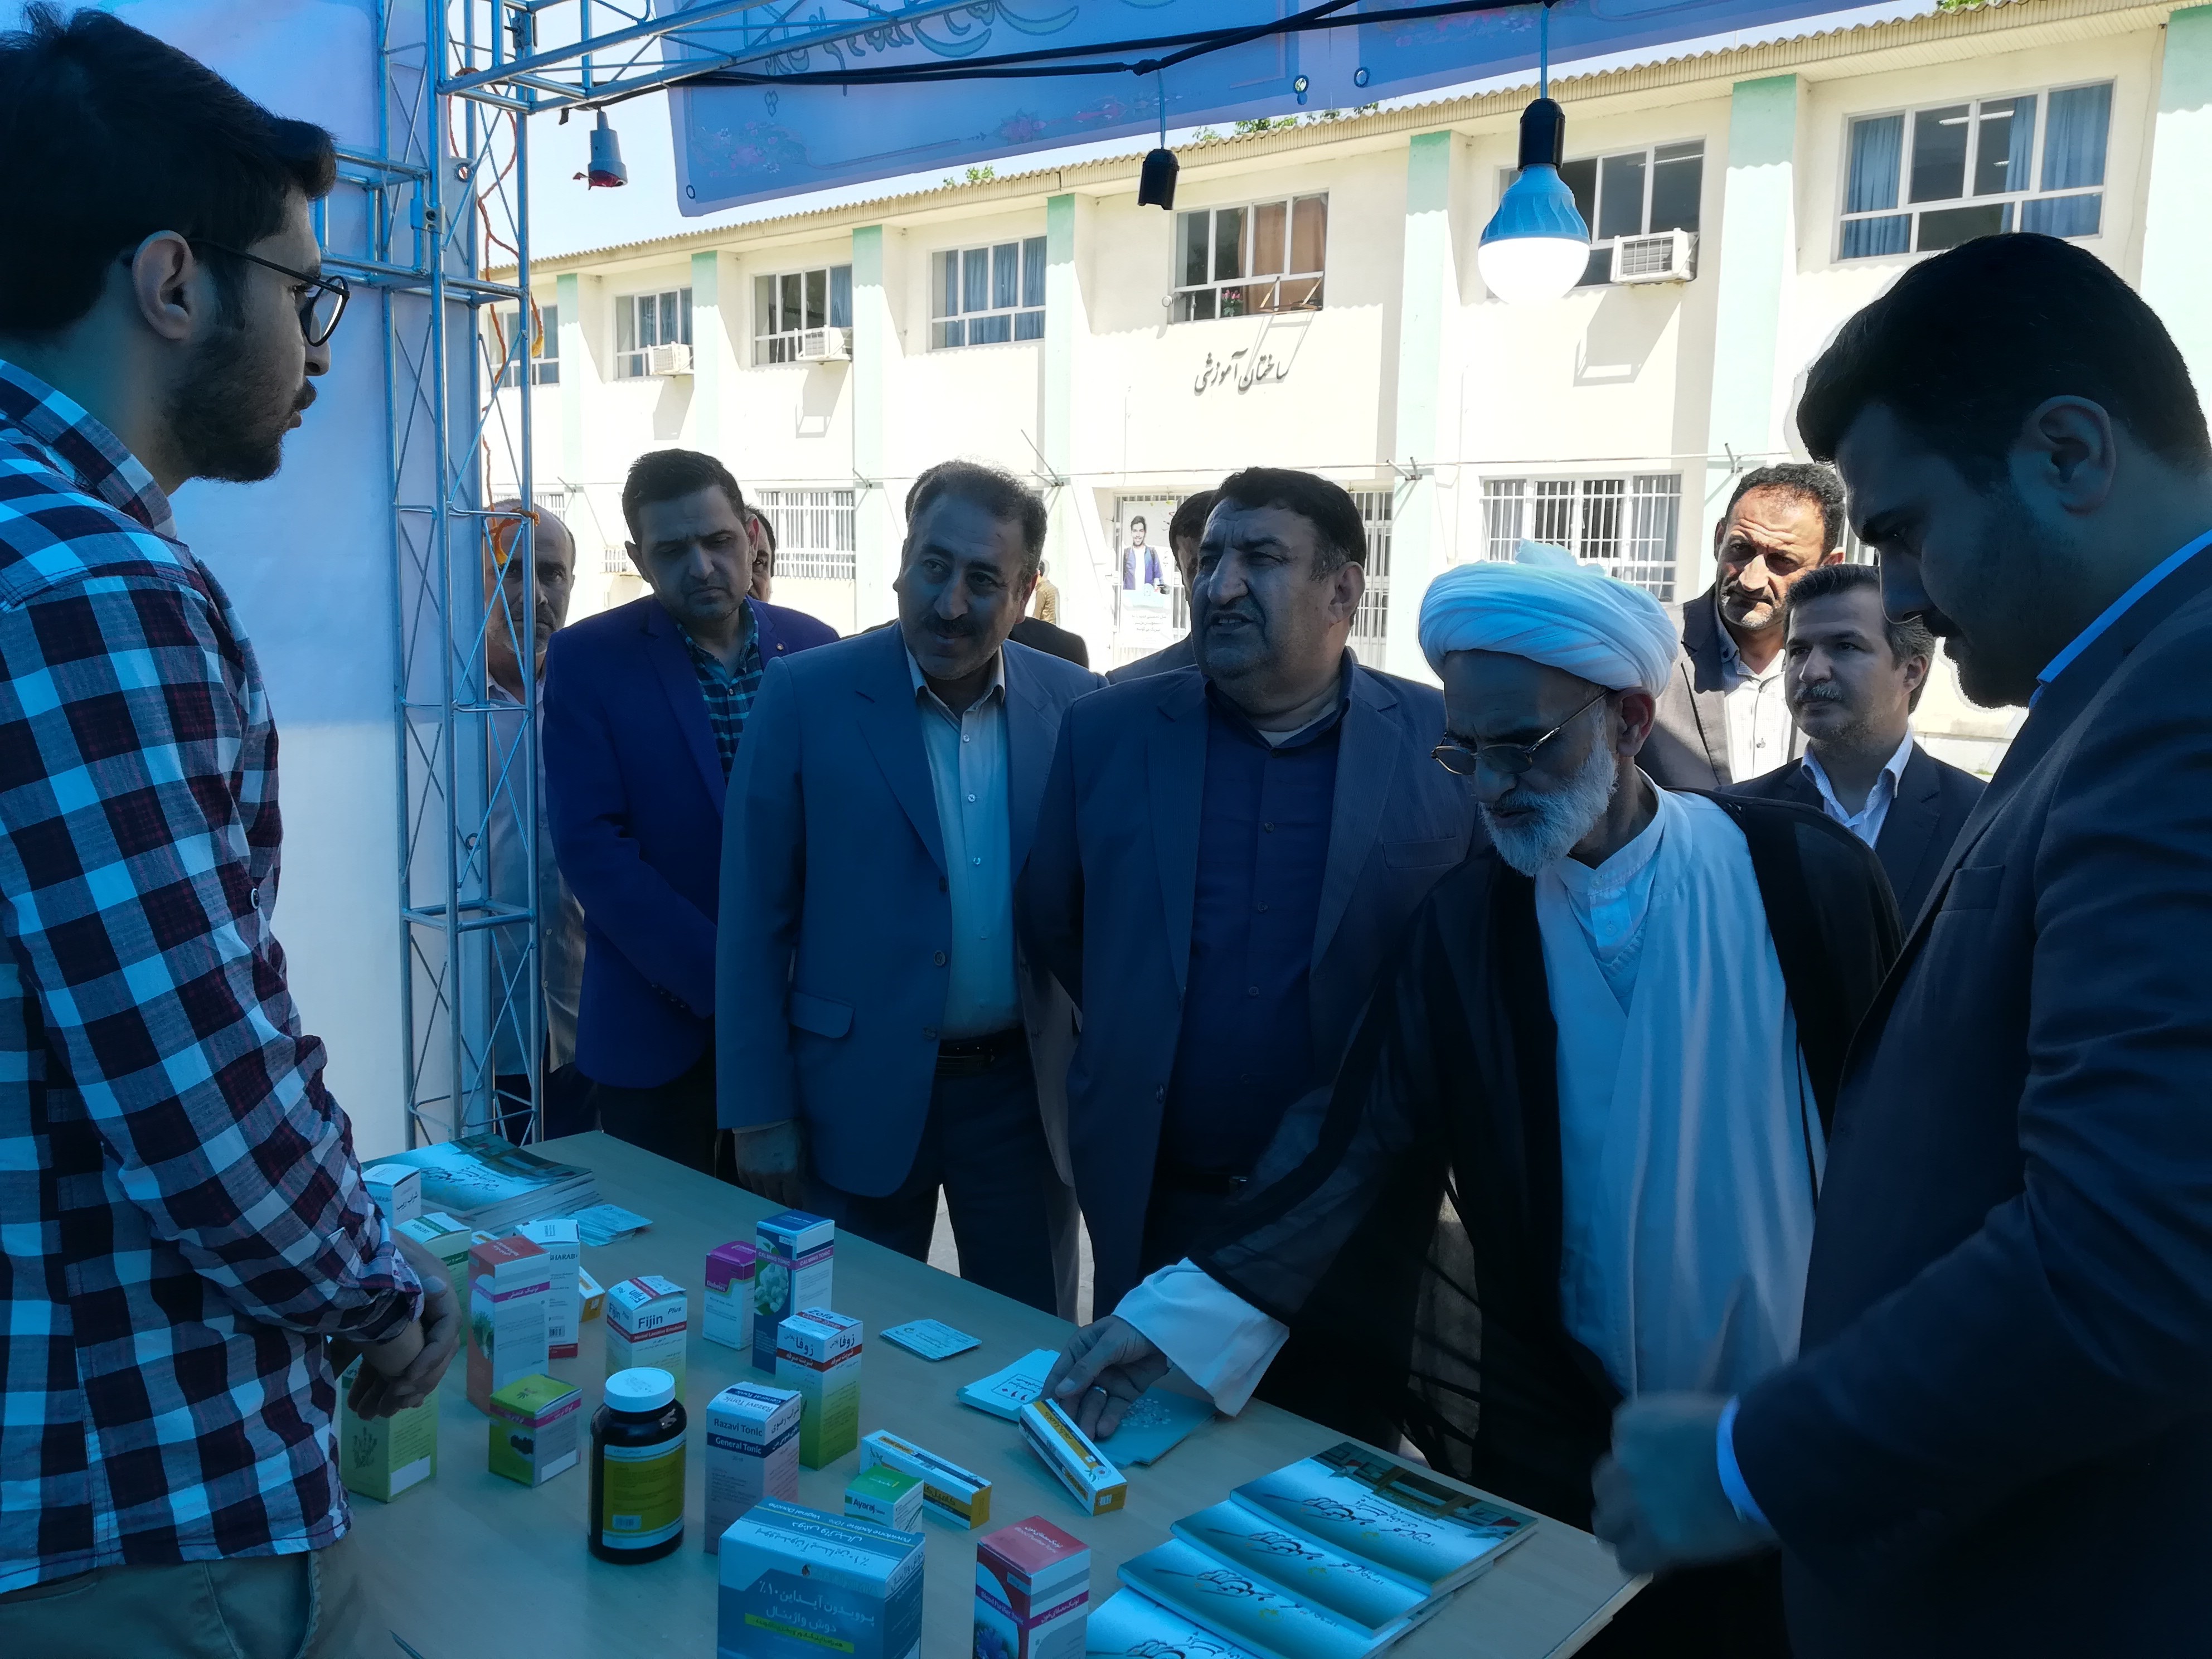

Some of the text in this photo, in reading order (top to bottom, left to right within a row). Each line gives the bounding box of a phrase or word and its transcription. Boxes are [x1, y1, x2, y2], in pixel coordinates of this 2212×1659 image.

[1194, 347, 1289, 393] ساختمان آموزشی
[758, 1251, 790, 1267] CALMING TONIC
[800, 1250, 831, 1266] CALMING TONIC
[629, 1289, 646, 1303] Fijin
[609, 1302, 620, 1321] Fijin
[808, 1309, 834, 1320] Zofa
[638, 1314, 663, 1329] Fijin
[802, 1313, 841, 1328] Cough Syrup
[796, 1336, 814, 1356] زوفا
[839, 1334, 855, 1349] زوفا
[786, 1353, 813, 1366] شربت سرفه
[831, 1349, 854, 1365] شربت سرفه
[723, 1396, 773, 1413] Razavi Tonic
[735, 1390, 781, 1404] General Tonic
[714, 1418, 763, 1437] Razavi Tonic
[771, 1405, 799, 1434] شراب رضوی
[715, 1437, 761, 1454] General Tonic
[768, 1502, 794, 1514] Douche
[795, 1508, 821, 1520] Vaginal
[853, 1498, 875, 1514] Ayaraj
[792, 1521, 863, 1542] دوش واژینال
[846, 1523, 872, 1534] Iodine
[873, 1529, 911, 1543] Povidone
[755, 1527, 807, 1547] پوویدون
[801, 1541, 851, 1557] آیداین
[779, 1589, 823, 1610] آیداین
[824, 1600, 875, 1627] پوویدون
[981, 1591, 1024, 1625] Blood Purifier Tonic
[766, 1606, 807, 1627] واژینال
[809, 1618, 837, 1633] دوش
